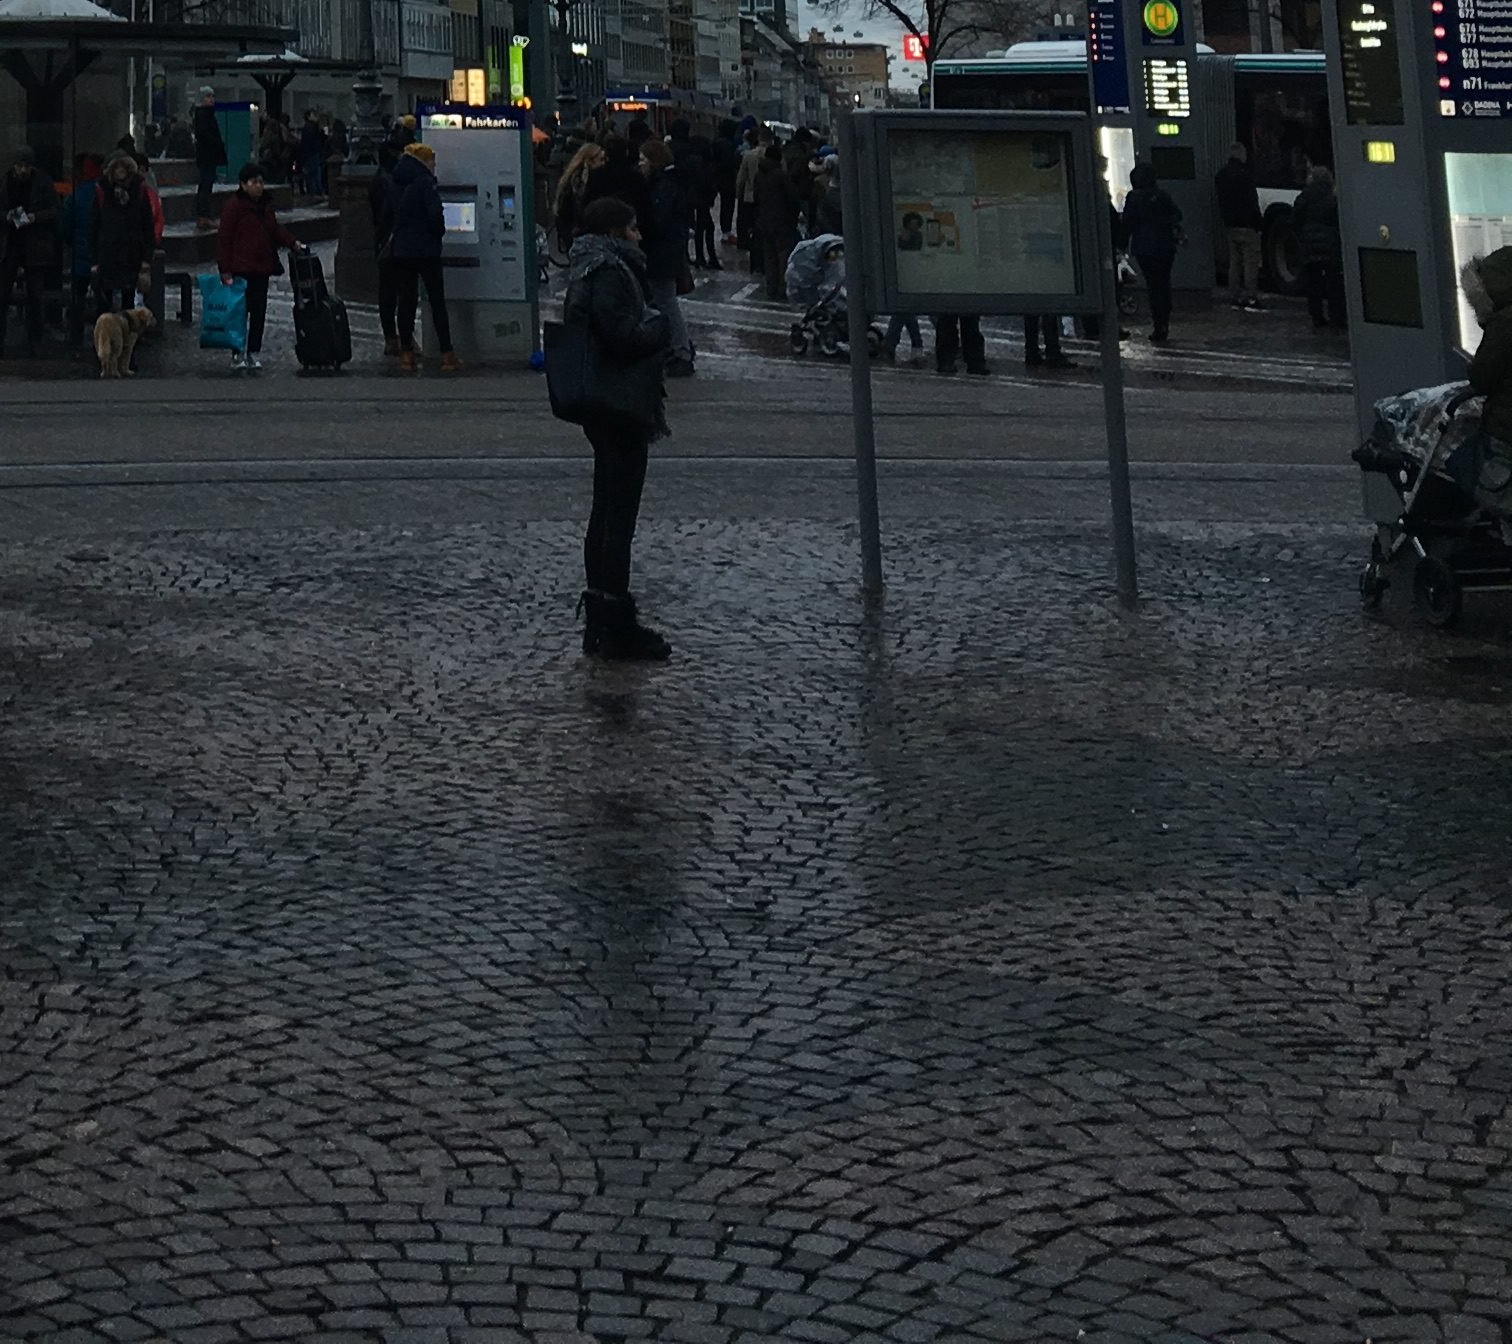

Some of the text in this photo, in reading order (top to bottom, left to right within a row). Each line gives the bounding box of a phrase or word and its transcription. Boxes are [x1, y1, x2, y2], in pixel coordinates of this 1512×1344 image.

[1458, 8, 1475, 19] 672
[1459, 22, 1476, 33] 674
[1463, 77, 1482, 90] n71
[465, 116, 519, 128] Fahrkarten
